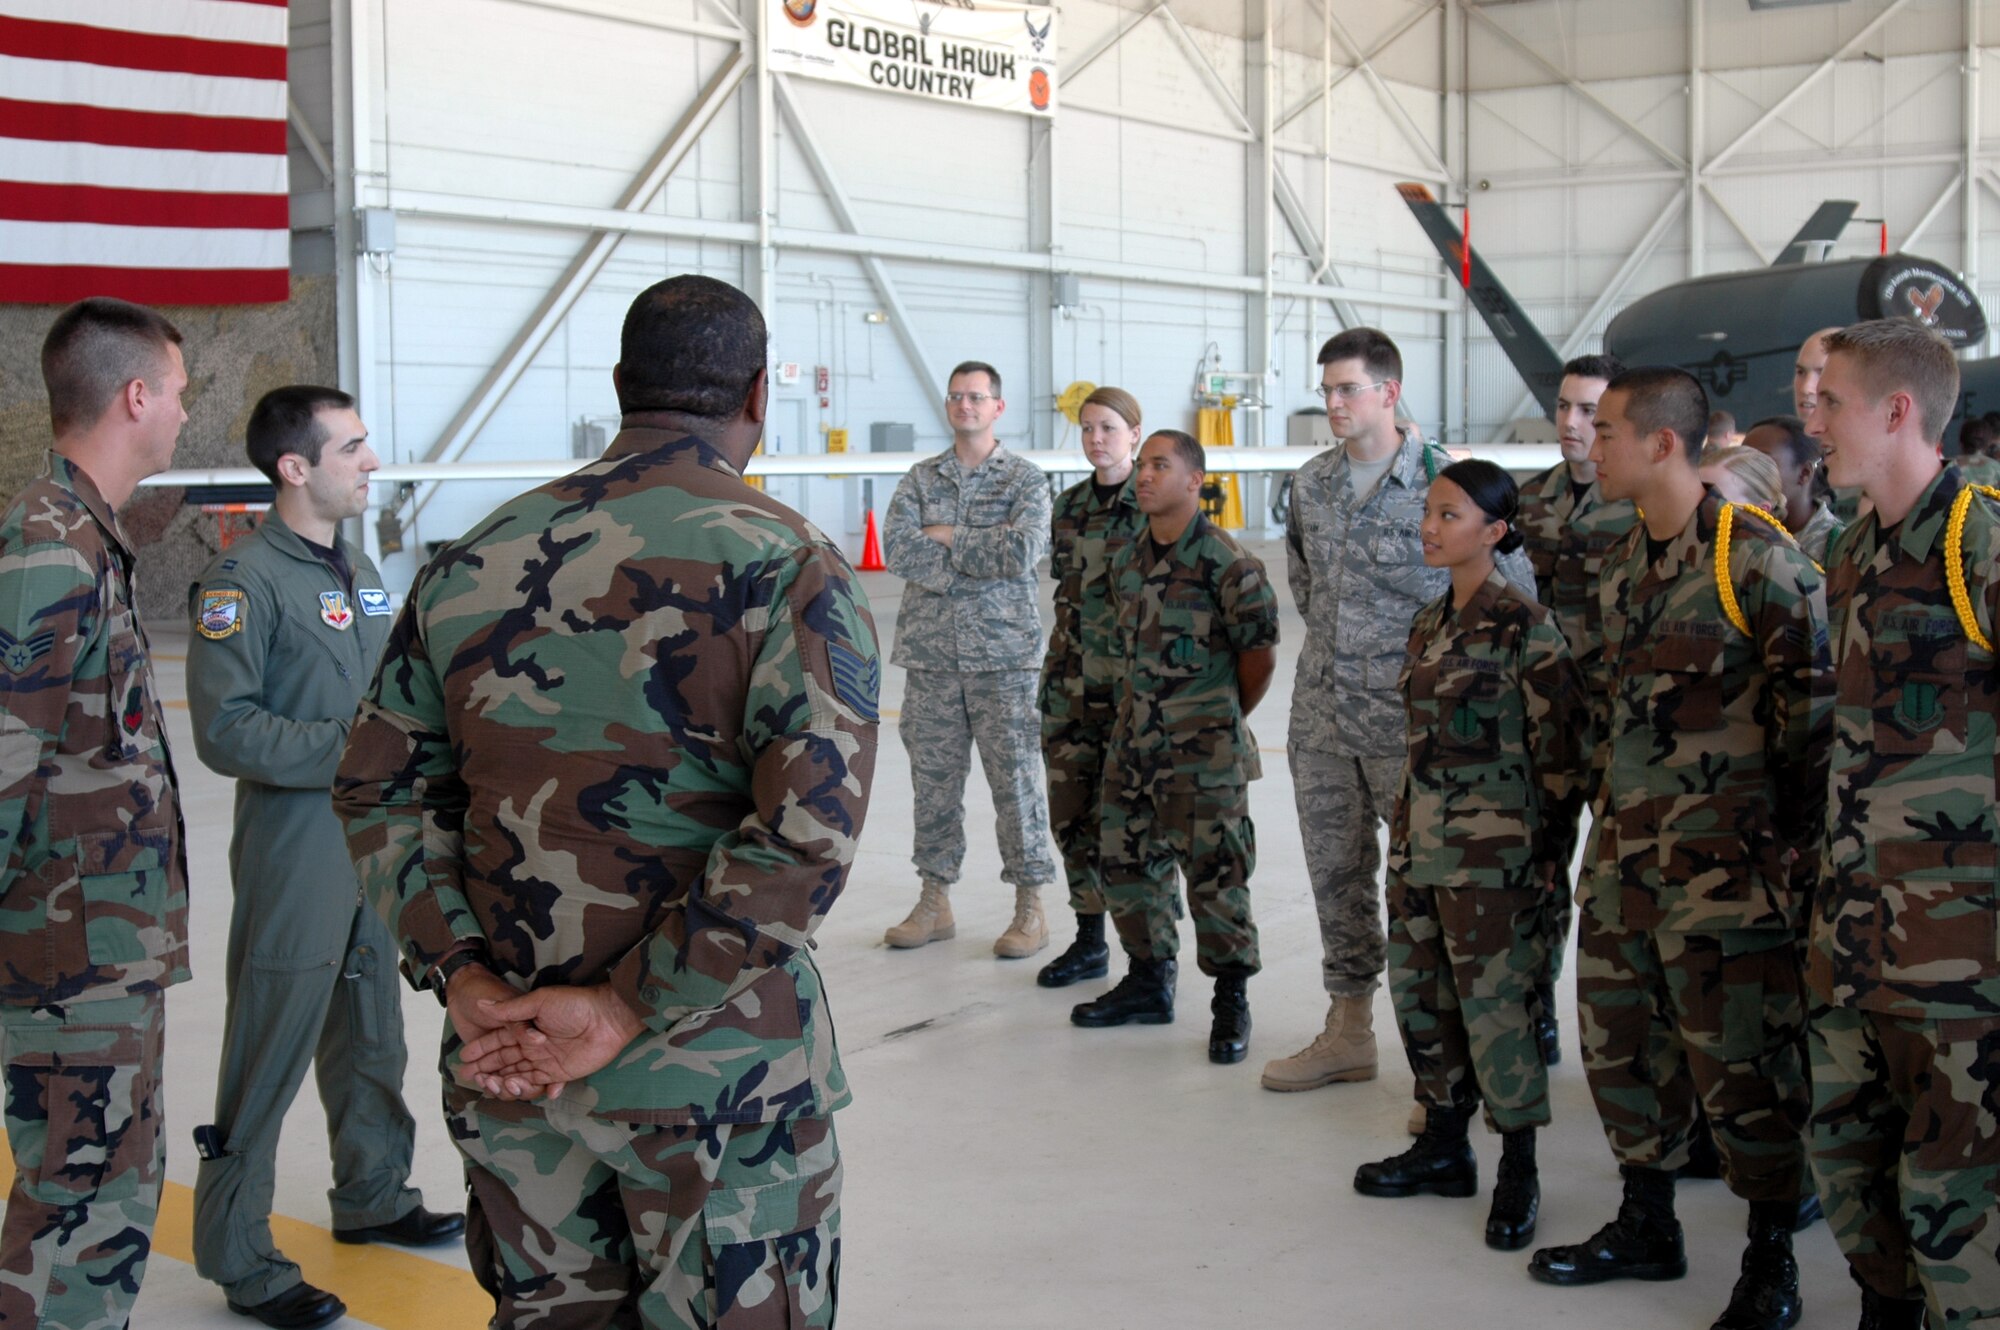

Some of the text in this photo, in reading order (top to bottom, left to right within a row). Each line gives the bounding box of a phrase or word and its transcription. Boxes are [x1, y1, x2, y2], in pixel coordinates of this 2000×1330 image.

[826, 18, 1016, 80] GLOBAL HAWK
[869, 60, 976, 100] COUNTRY
[1912, 267, 1957, 293] Maintenance
[1674, 622, 1686, 634] AIR
[1690, 623, 1718, 636] FORCE
[1901, 617, 1919, 631] AIR
[1471, 659, 1501, 673] FORCE
